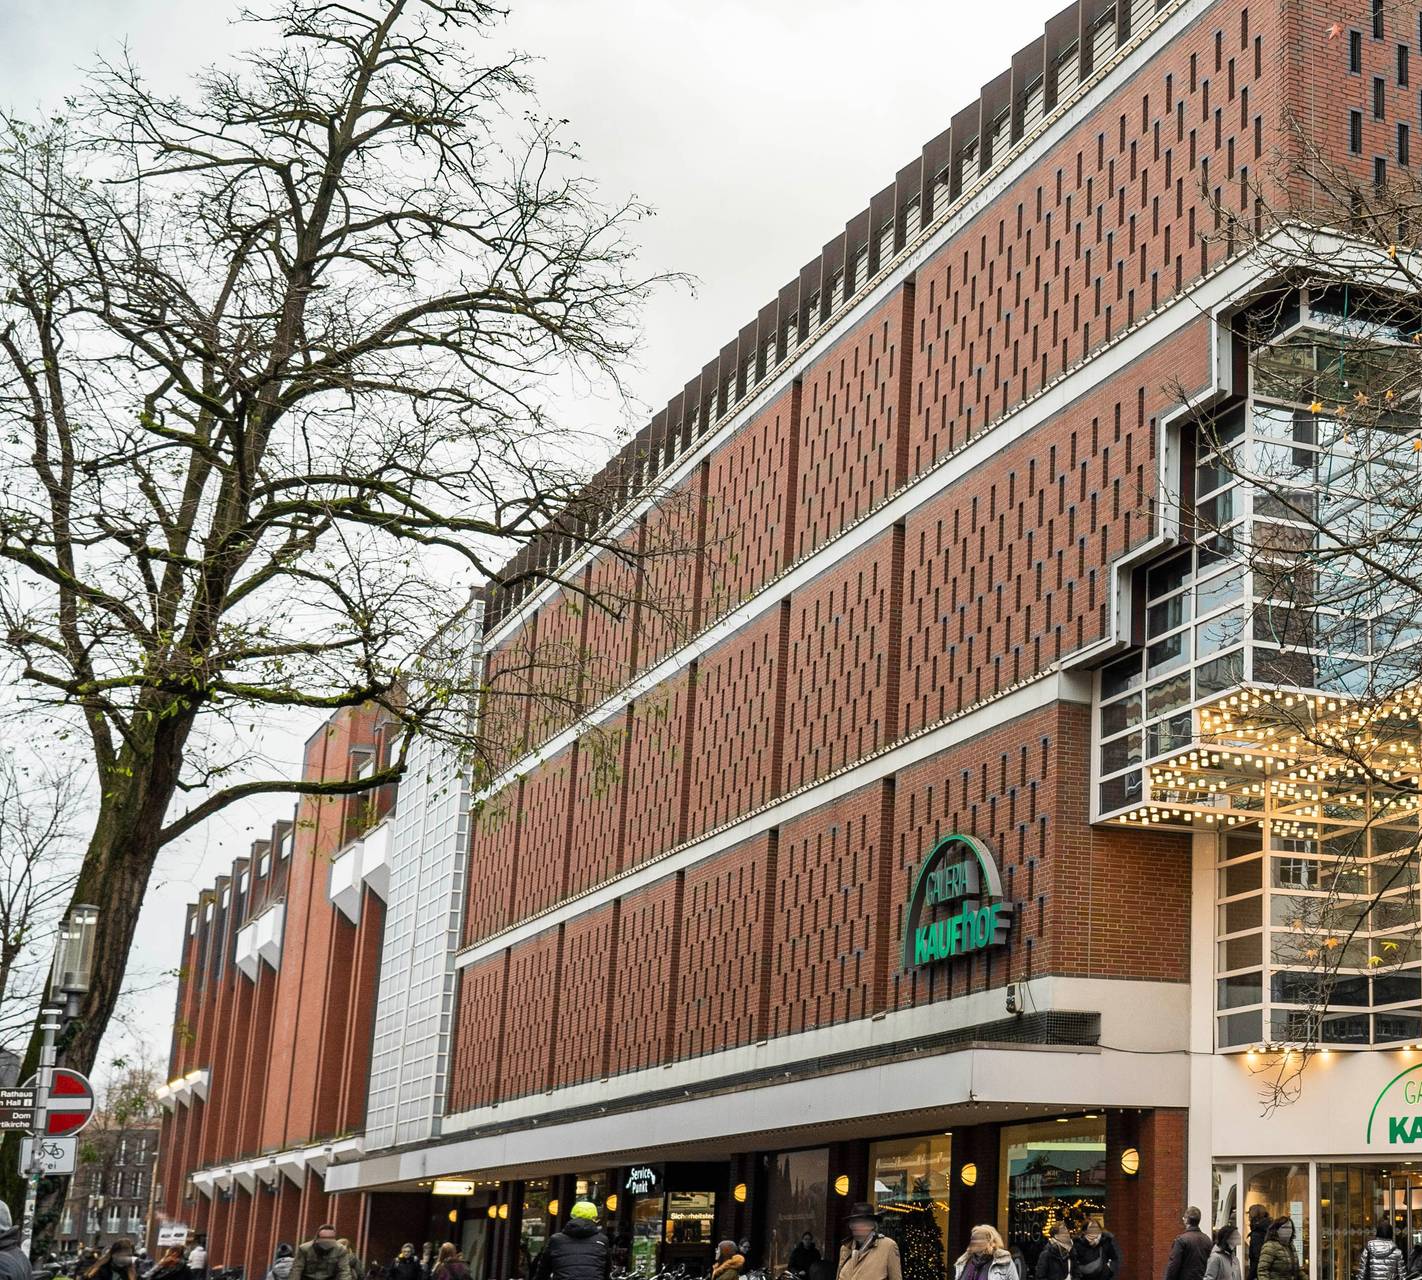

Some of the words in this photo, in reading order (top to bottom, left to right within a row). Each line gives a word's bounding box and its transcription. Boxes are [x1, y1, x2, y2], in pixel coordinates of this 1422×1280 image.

[926, 860, 969, 906] GALERIA
[1, 1090, 33, 1098] Rathaus
[631, 1166, 651, 1180] Service
[632, 1180, 648, 1195] Punkt
